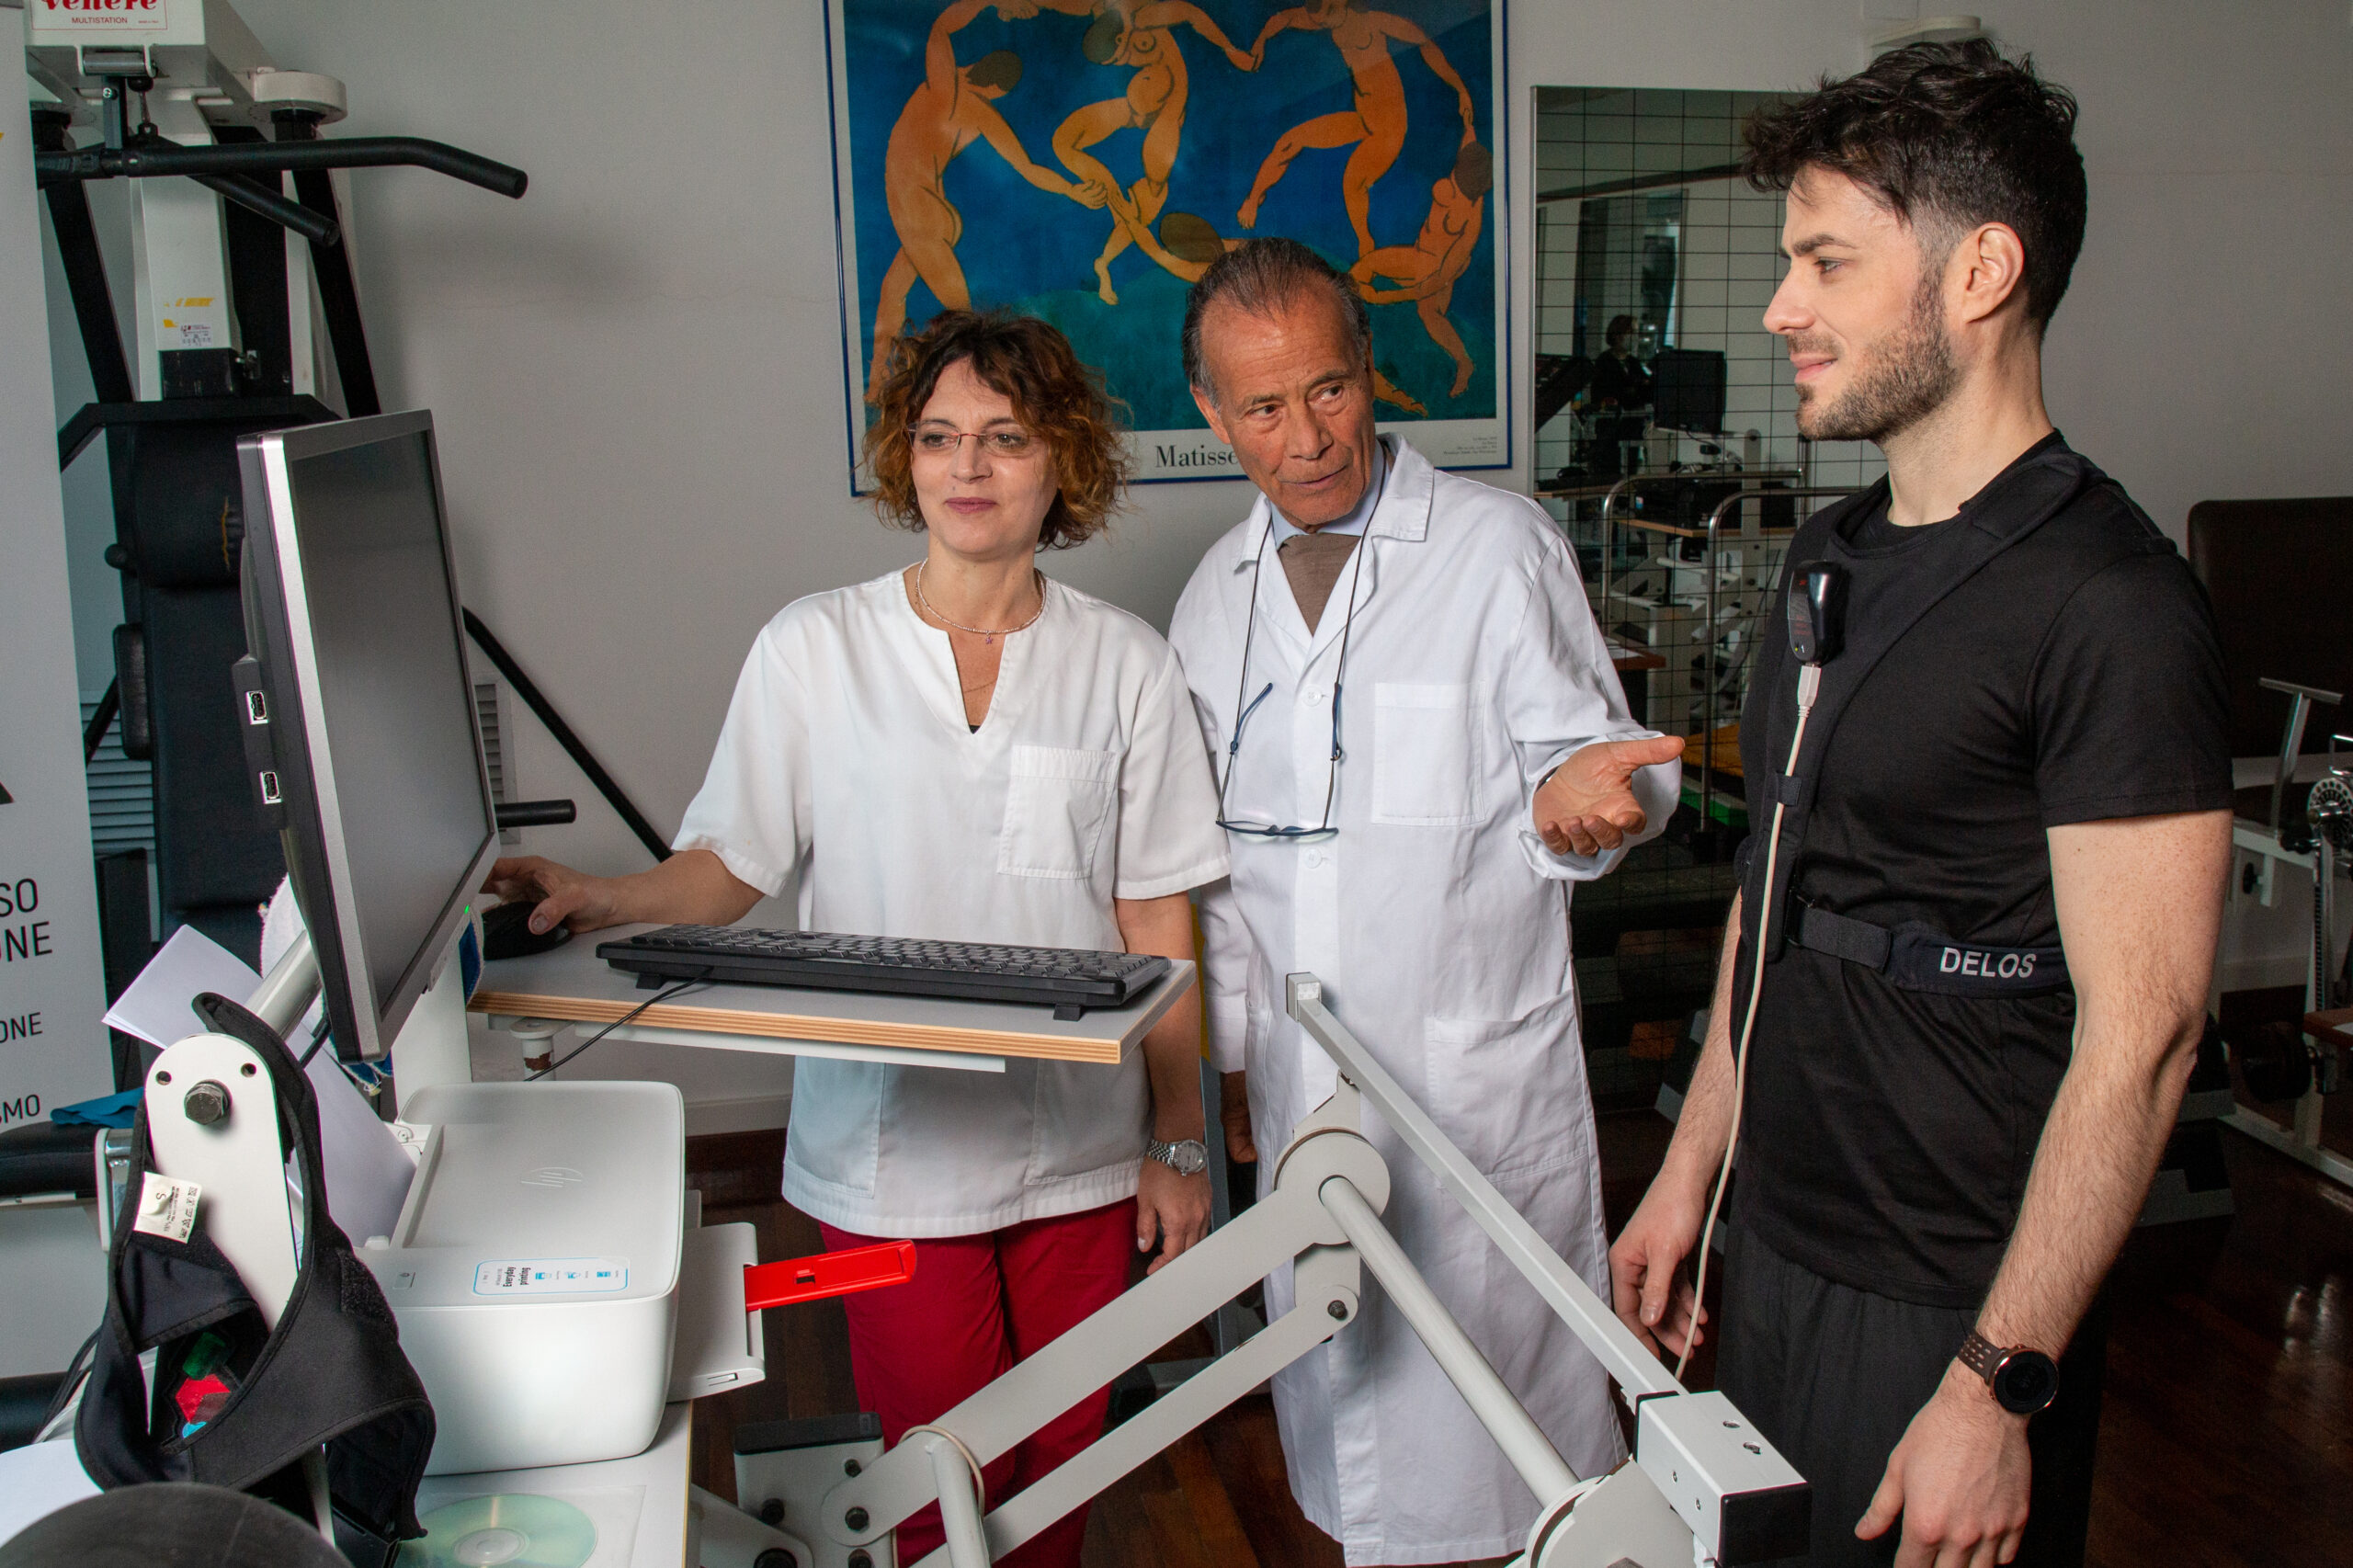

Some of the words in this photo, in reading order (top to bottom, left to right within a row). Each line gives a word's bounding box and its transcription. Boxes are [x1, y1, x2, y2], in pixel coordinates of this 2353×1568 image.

[1154, 444, 1238, 468] Matisse
[0, 921, 52, 962] NE
[1939, 947, 2037, 978] DELOS
[0, 1094, 40, 1124] MO
[503, 1267, 516, 1287] Everyday
[520, 1267, 531, 1285] printing
